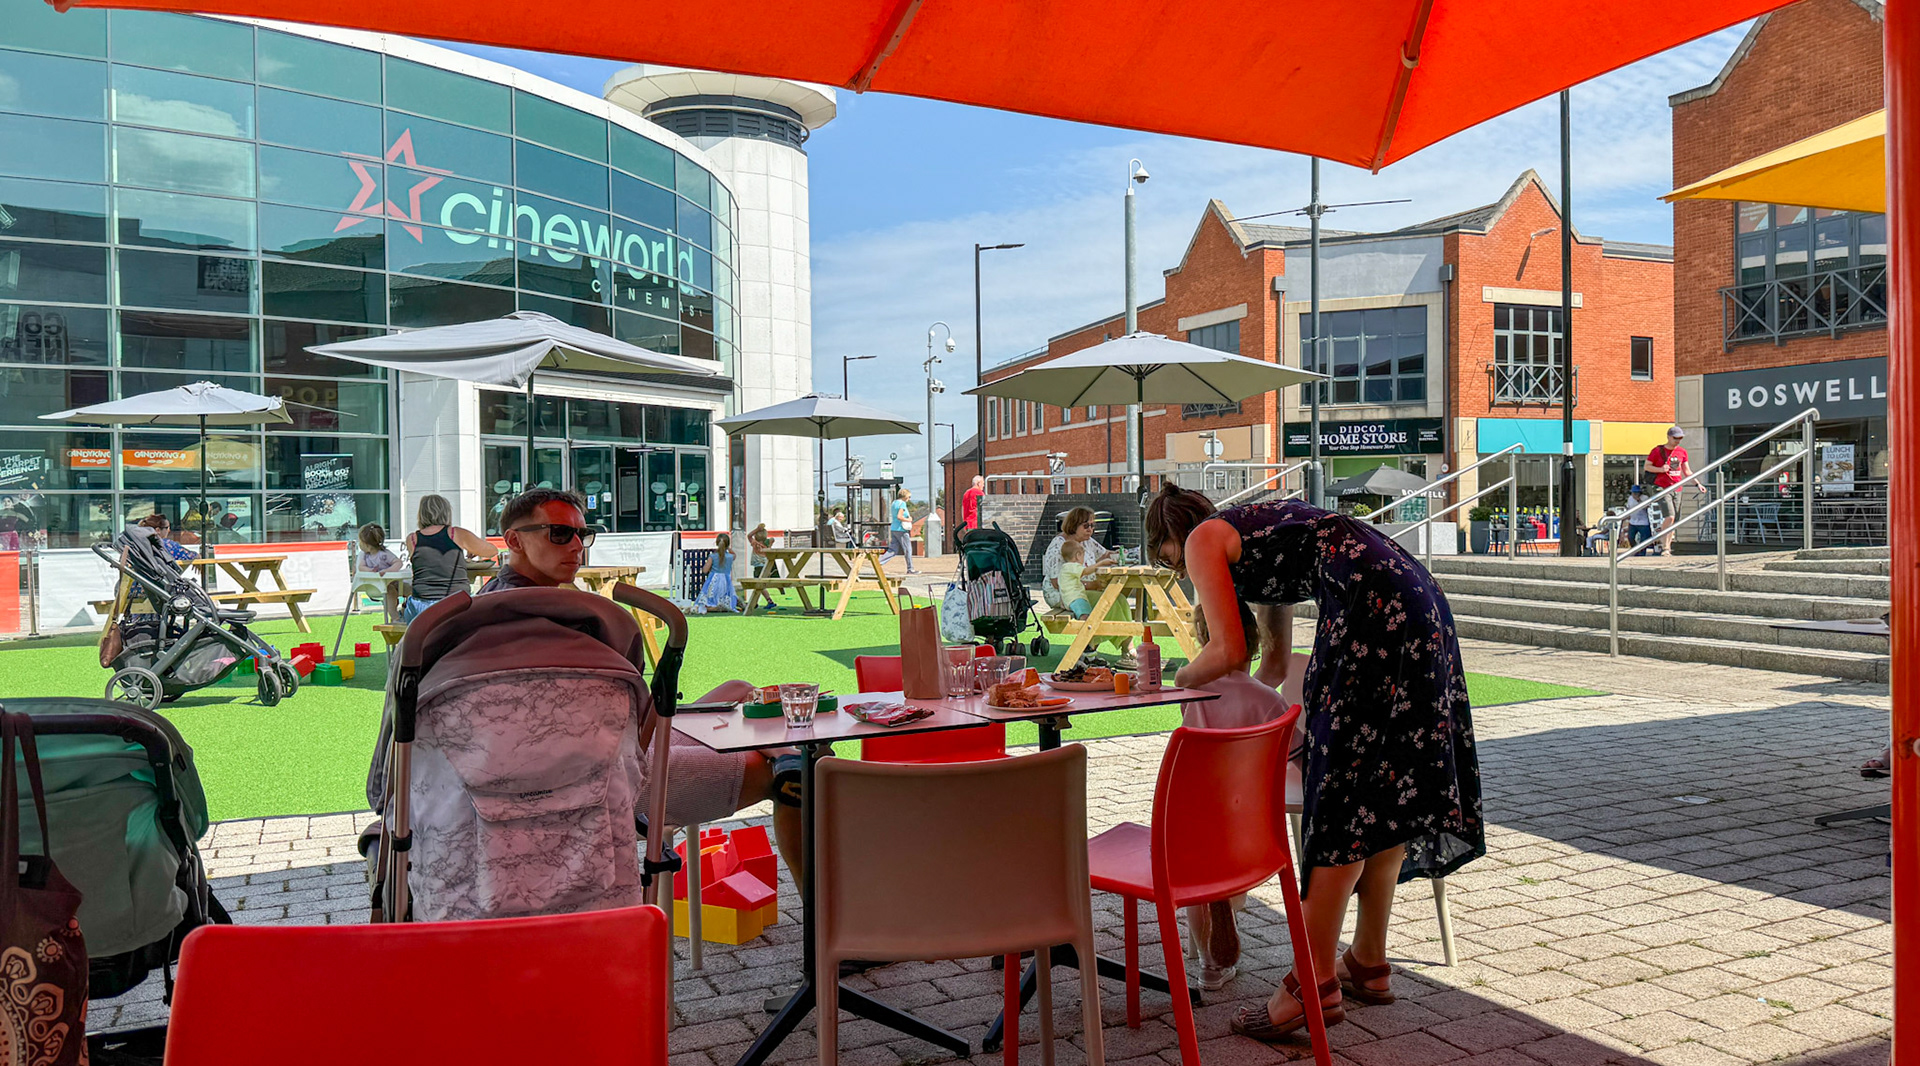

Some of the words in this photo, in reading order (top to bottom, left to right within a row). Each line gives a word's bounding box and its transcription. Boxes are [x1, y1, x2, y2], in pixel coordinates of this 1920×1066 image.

[440, 187, 695, 296] cineworld
[592, 279, 695, 317] CINEMAS
[1339, 425, 1385, 433] DIDCOT
[1319, 434, 1360, 445] HOME
[1362, 432, 1407, 444] STORE
[0, 456, 41, 471] -CARPET
[2, 454, 21, 465] THE
[305, 458, 337, 471] ALRIGHT
[334, 466, 350, 476] GOT
[306, 473, 349, 490] DISCOUNTS
